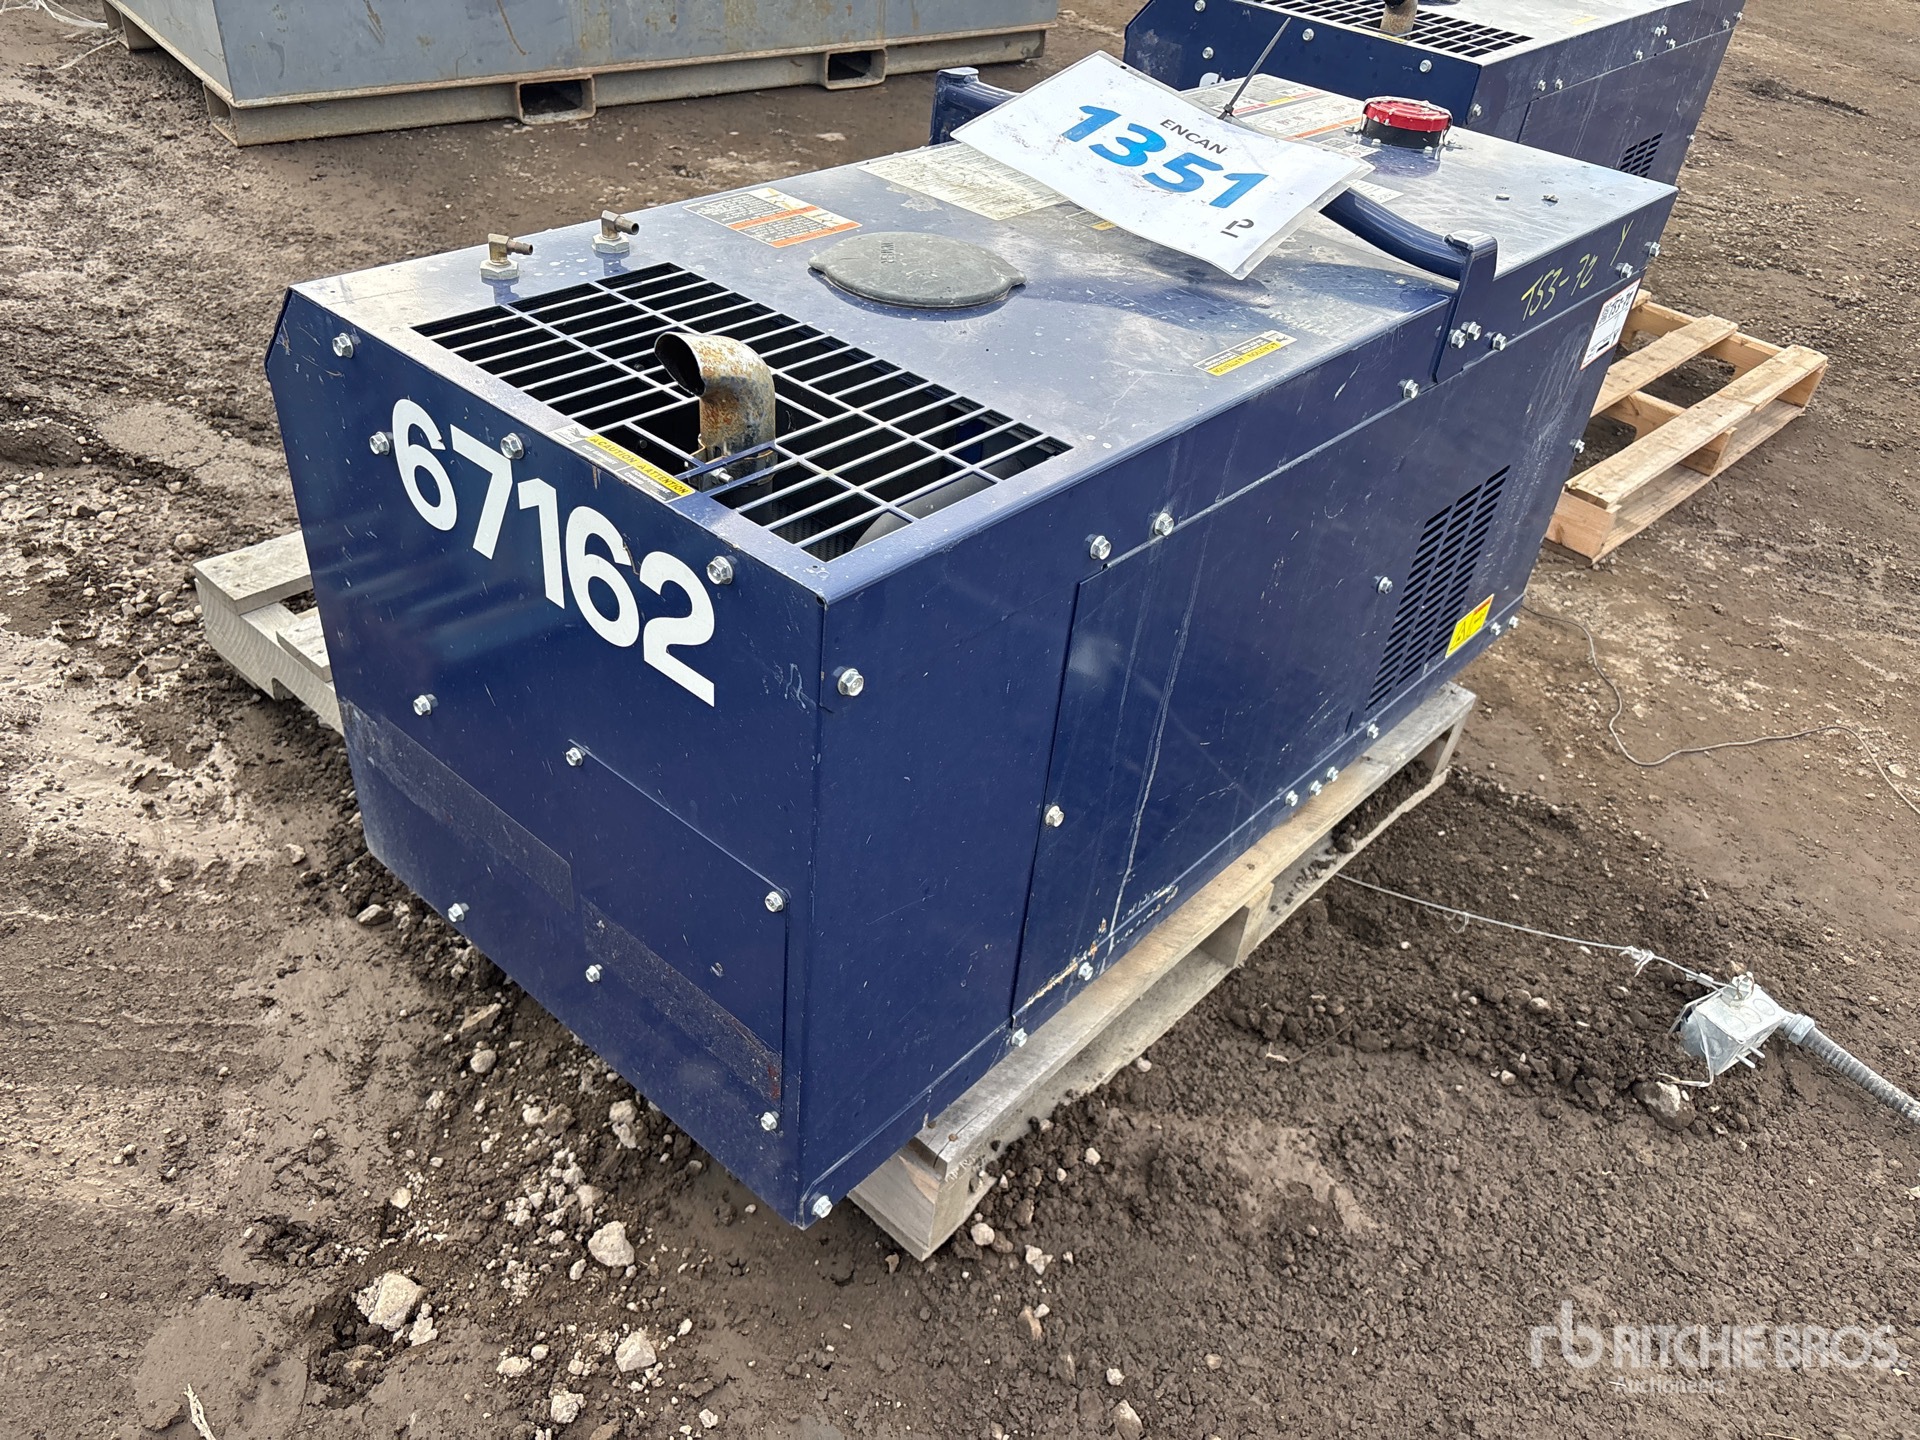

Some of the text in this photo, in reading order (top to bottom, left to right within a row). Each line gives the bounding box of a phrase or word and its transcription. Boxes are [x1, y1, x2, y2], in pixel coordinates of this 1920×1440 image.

[1061, 105, 1269, 208] 1351
[1160, 118, 1228, 155] ENCAN
[598, 440, 689, 494] CAUTION ATTENTION
[391, 398, 716, 708] 67162
